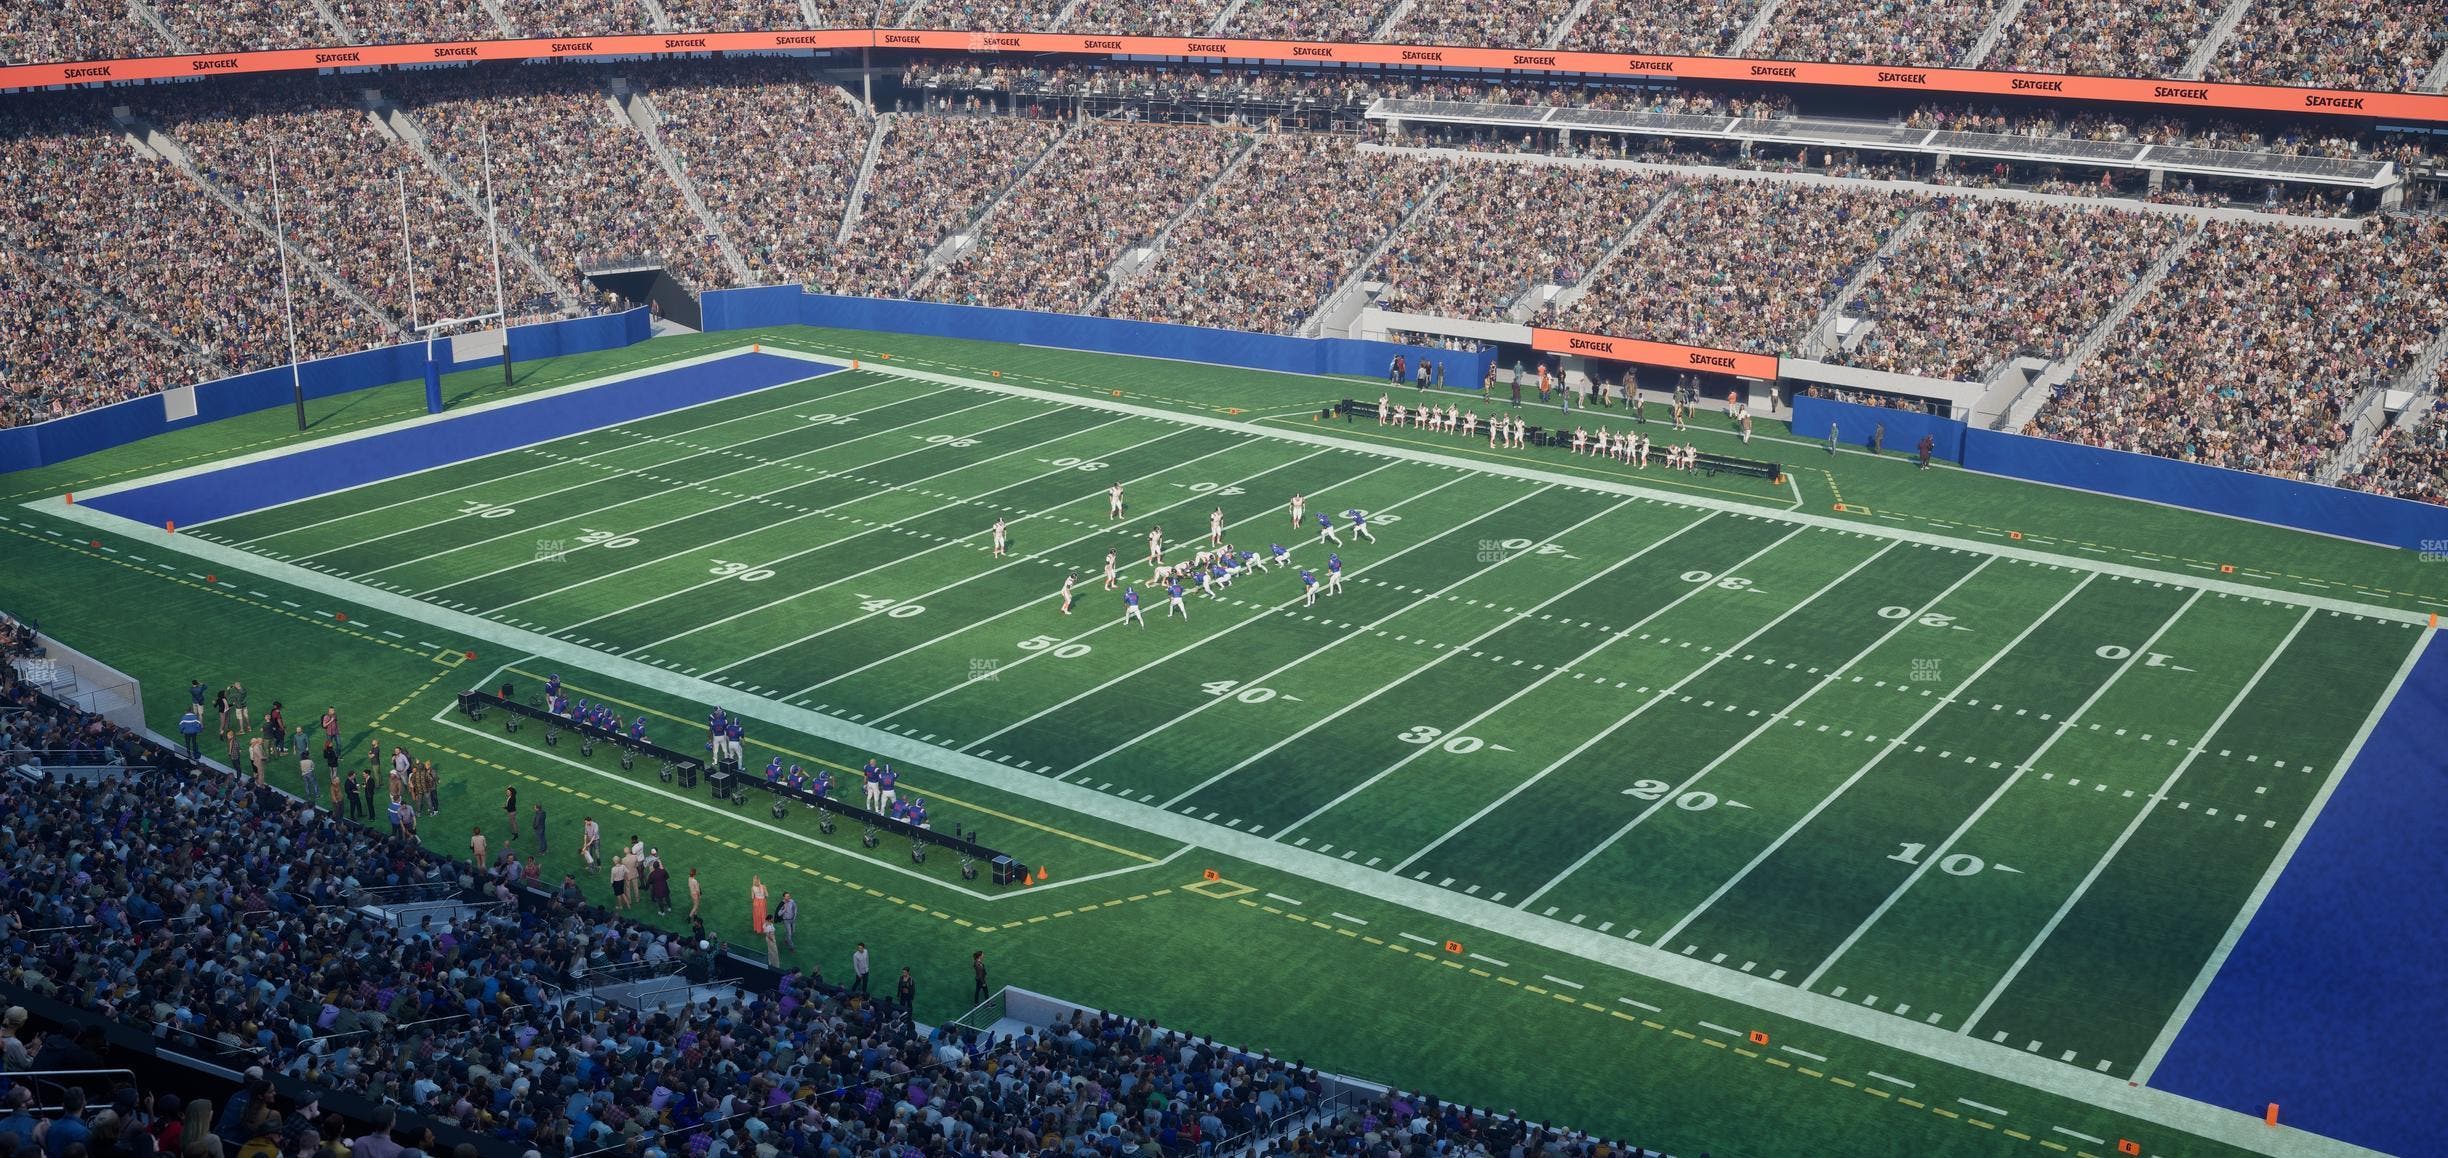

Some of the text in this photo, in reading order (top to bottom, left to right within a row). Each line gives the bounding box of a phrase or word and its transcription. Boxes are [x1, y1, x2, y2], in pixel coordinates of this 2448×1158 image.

[665, 38, 705, 49] SEATGEEK
[776, 35, 816, 45] SEATGEEK
[884, 35, 921, 45] SEATGEEK
[983, 37, 1020, 47] SEATGEEK
[1084, 40, 1122, 50] SEATGEEK
[434, 46, 478, 58] SEATGEEK
[551, 42, 593, 53] SEATGEEK
[1188, 43, 1226, 53] SEATGEEK
[1293, 46, 1332, 57] SEATGEEK
[315, 52, 360, 64] SEATGEEK
[1402, 50, 1442, 62] SEATGEEK
[1513, 55, 1556, 66] SEATGEEK
[192, 58, 239, 71] SEATGEEK
[1629, 60, 1673, 72] SEATGEEK
[1751, 65, 1796, 78] SEATGEEK
[63, 66, 111, 79] SEATGEEK
[1877, 72, 1926, 84] SEATGEEK
[2011, 78, 2063, 92] SEATGEEK
[2154, 86, 2209, 101] SEATGEEK
[2305, 95, 2364, 110] SEATGEEK
[1569, 338, 1613, 354] SEATGEEK
[1689, 353, 1736, 369] SEATGEEK
[808, 413, 860, 425] 10
[925, 434, 982, 447] 20
[1051, 457, 1110, 472] 30
[1189, 482, 1246, 496] 40
[457, 503, 516, 518] 10
[1338, 509, 1402, 525] 50
[574, 531, 640, 548] 20
[1501, 538, 1566, 554] 40
[709, 562, 776, 581] 30
[1680, 570, 1753, 590] 30
[859, 598, 926, 618] 40
[1877, 606, 1957, 627] 20
[1017, 635, 1092, 658] 50
[2095, 645, 2174, 667] 10
[1201, 680, 1277, 703] 40
[1397, 725, 1484, 754] 30
[1621, 779, 1718, 811] 20
[1886, 842, 1985, 876] 10
[1755, 1033, 1763, 1042] 10
